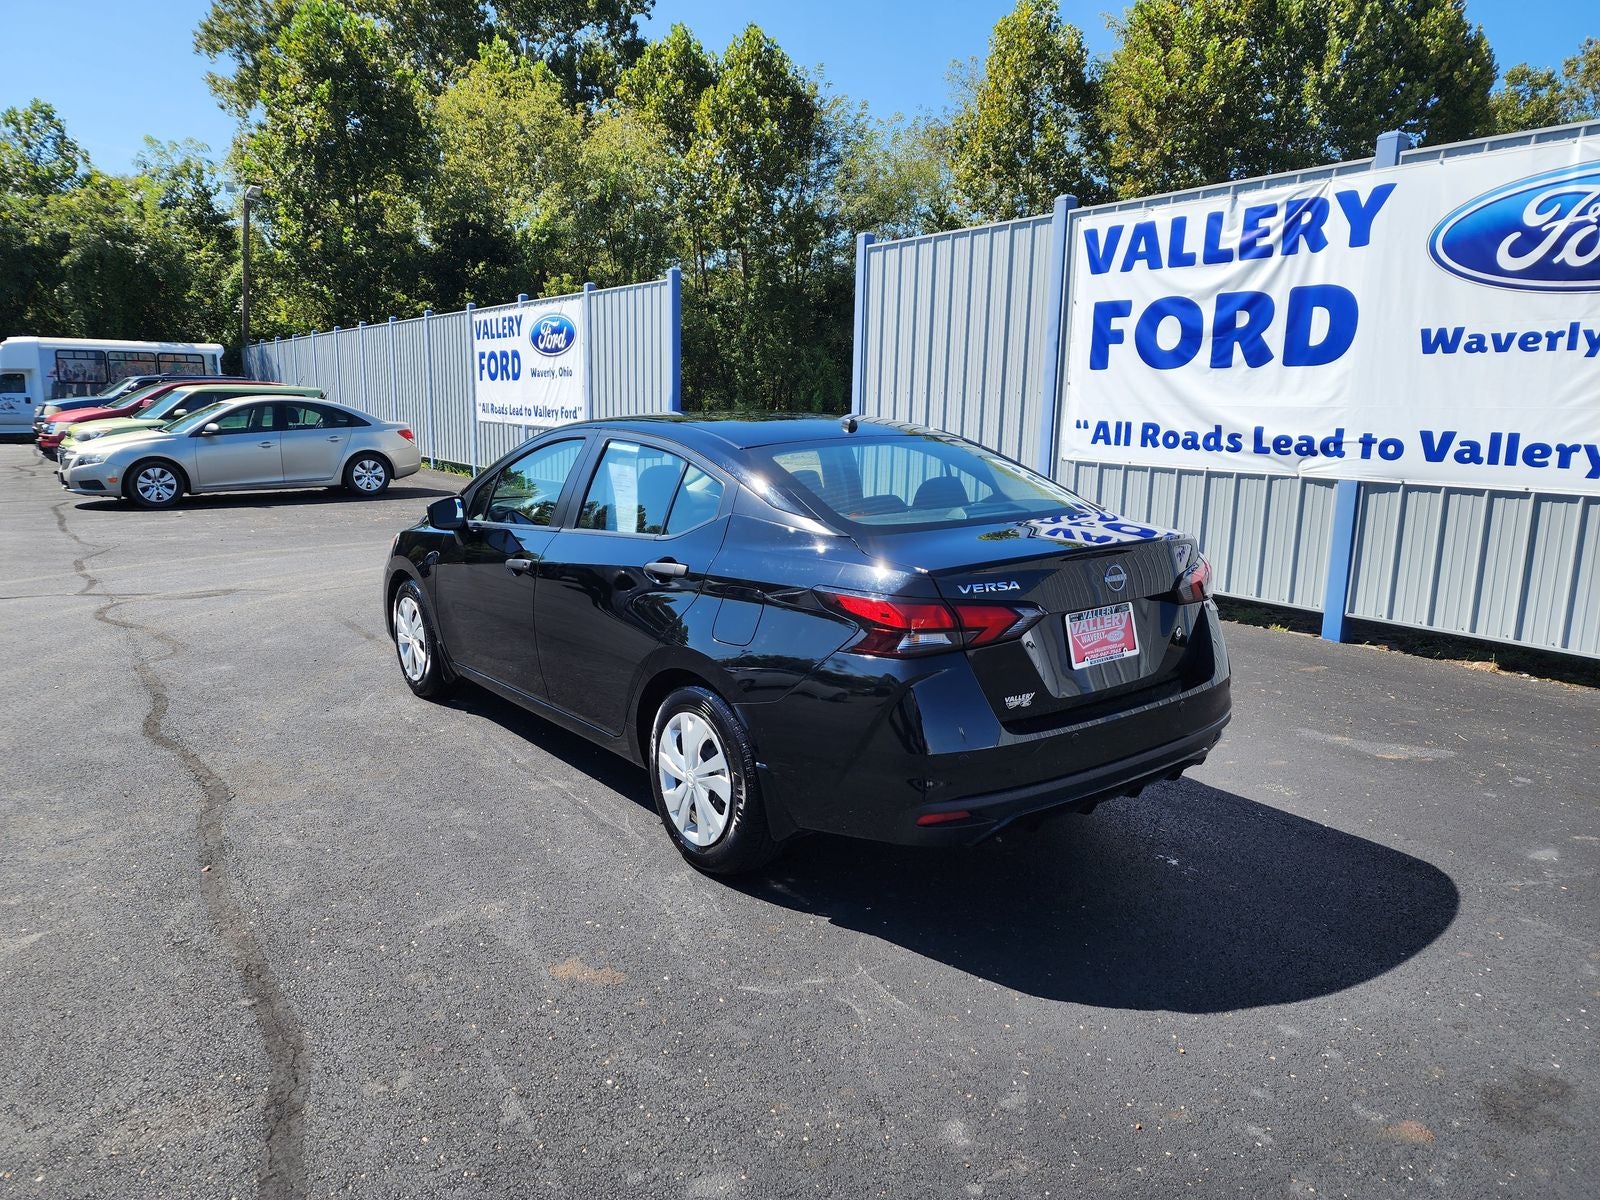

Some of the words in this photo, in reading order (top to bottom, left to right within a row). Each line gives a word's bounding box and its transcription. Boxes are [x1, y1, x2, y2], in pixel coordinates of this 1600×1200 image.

[1083, 182, 1399, 275] VALLERY
[475, 314, 523, 340] VALLERY
[537, 320, 567, 350] Ford
[1089, 284, 1359, 370] FORD
[478, 349, 521, 381] FORD
[530, 367, 558, 379] Waverly,
[558, 366, 573, 377] Ohio
[490, 403, 508, 416] Roads
[509, 404, 523, 416] Lead
[524, 406, 532, 417] to
[533, 405, 559, 421] Vallery
[1140, 424, 1243, 453] Roads
[1253, 426, 1346, 458] Lead
[1359, 432, 1405, 461] to
[957, 580, 1021, 594] VERSA
[1070, 612, 1129, 634] VALLERY
[1082, 606, 1116, 620] VALLERY
[1005, 691, 1035, 703] VALLERY
